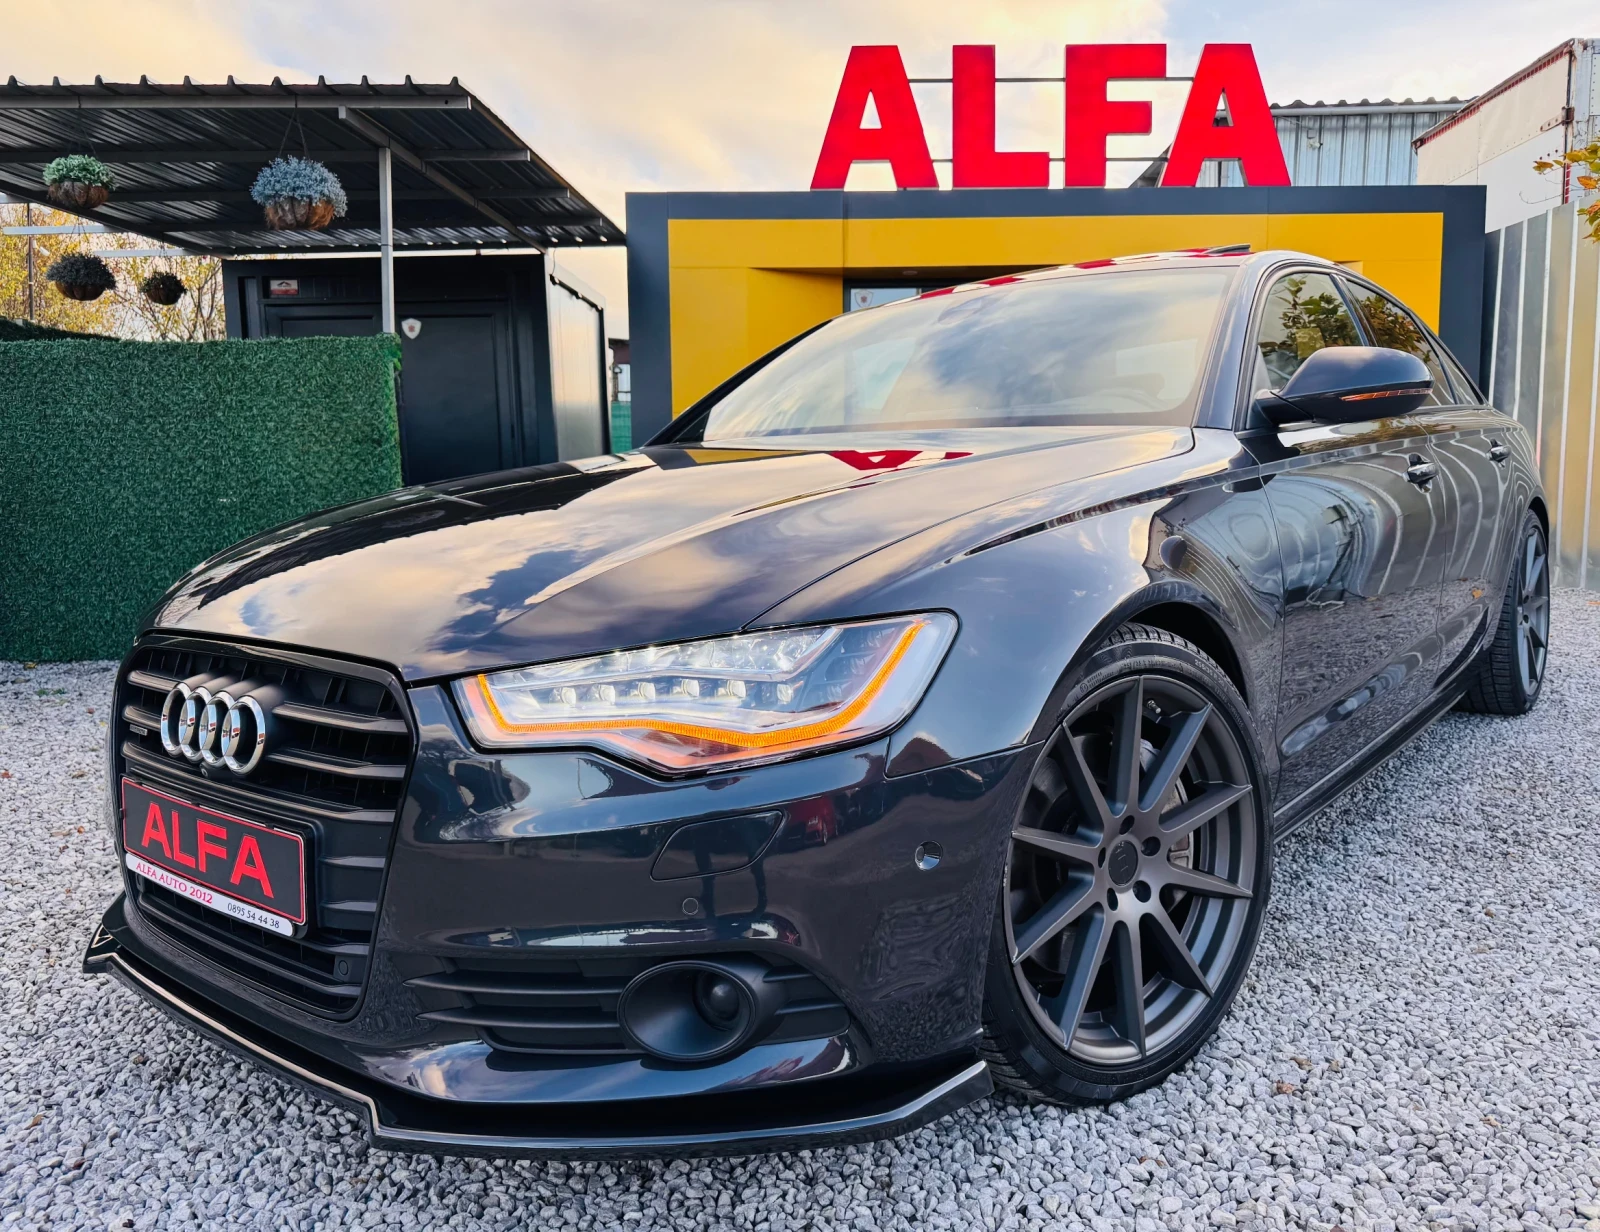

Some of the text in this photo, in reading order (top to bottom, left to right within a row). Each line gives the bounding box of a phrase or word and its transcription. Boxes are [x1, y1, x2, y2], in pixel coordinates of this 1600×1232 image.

[809, 43, 1292, 190] ALFA
[135, 862, 213, 904] ALFA AUTO 2012
[141, 802, 274, 899] ALFA
[227, 902, 280, 929] 0895 54 44 38
